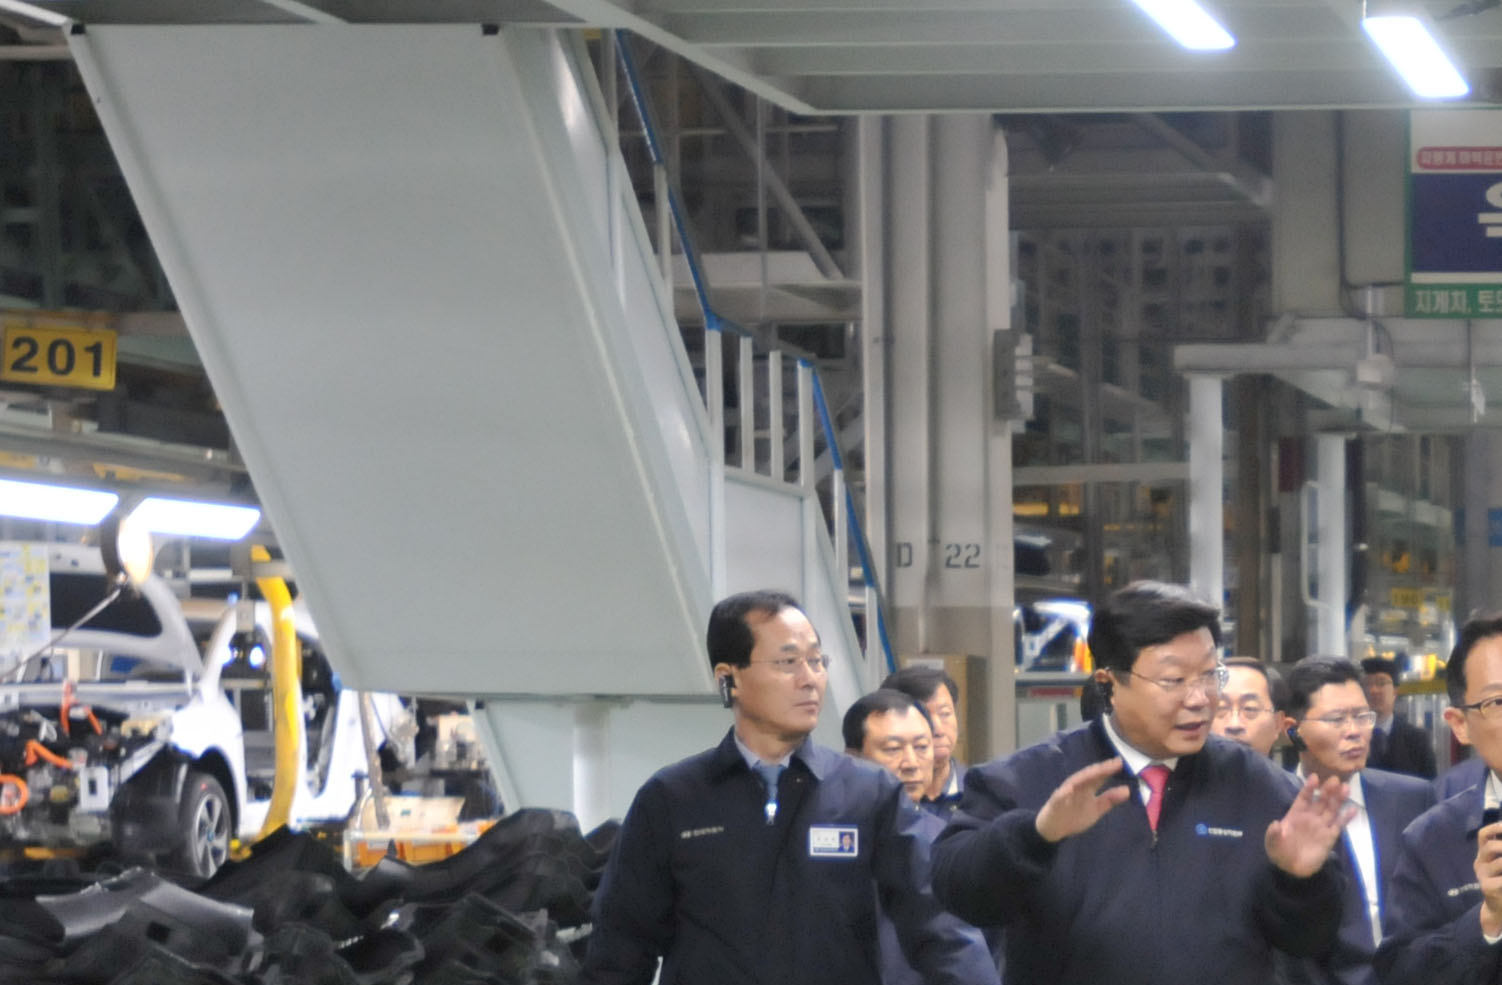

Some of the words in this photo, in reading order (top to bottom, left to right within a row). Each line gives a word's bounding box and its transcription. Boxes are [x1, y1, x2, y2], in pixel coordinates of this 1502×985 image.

[10, 335, 103, 378] 201
[895, 542, 913, 568] D
[945, 543, 981, 569] 22
